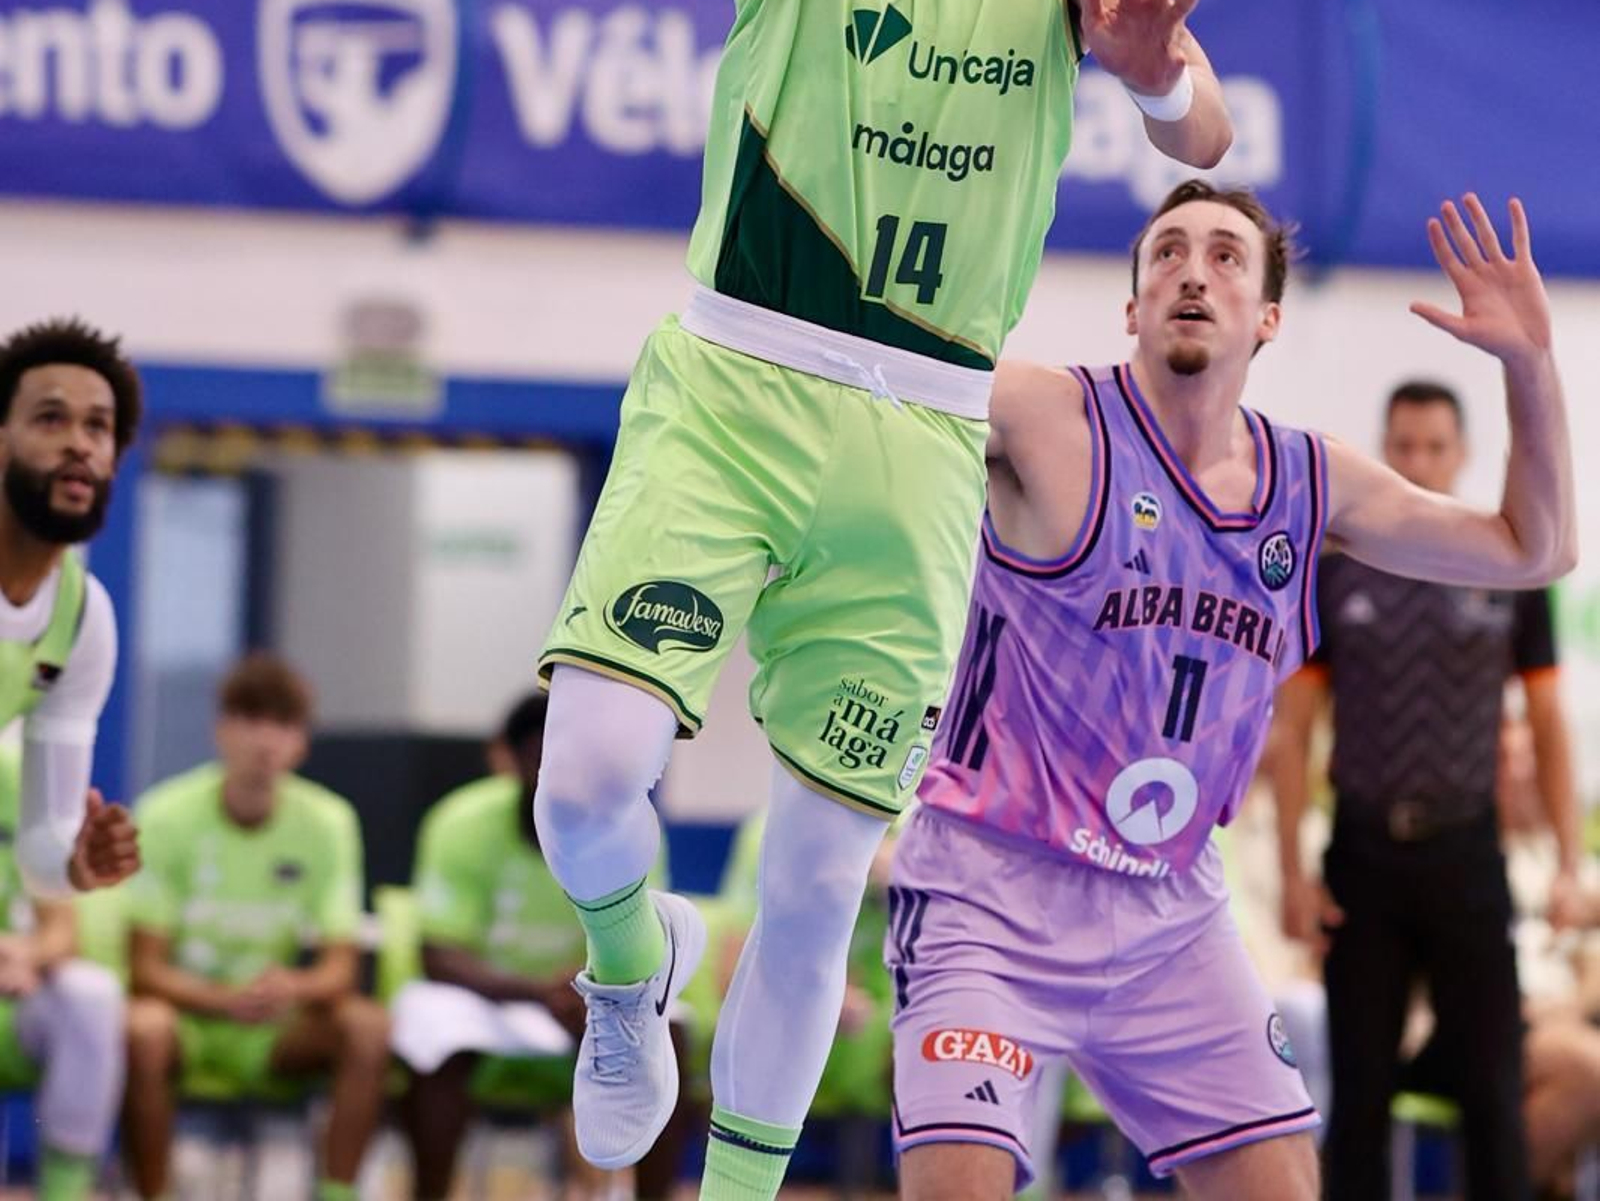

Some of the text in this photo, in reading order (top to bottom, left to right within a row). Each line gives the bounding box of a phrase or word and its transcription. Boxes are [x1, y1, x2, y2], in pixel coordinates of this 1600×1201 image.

[493, 5, 721, 156] Vél
[908, 41, 1035, 96] Uncaja
[865, 214, 948, 305] 14
[616, 584, 722, 639] famadesa
[1093, 586, 1184, 631] ALBA
[839, 678, 889, 708] sabor
[1161, 654, 1208, 743] 11
[817, 710, 888, 769] laga
